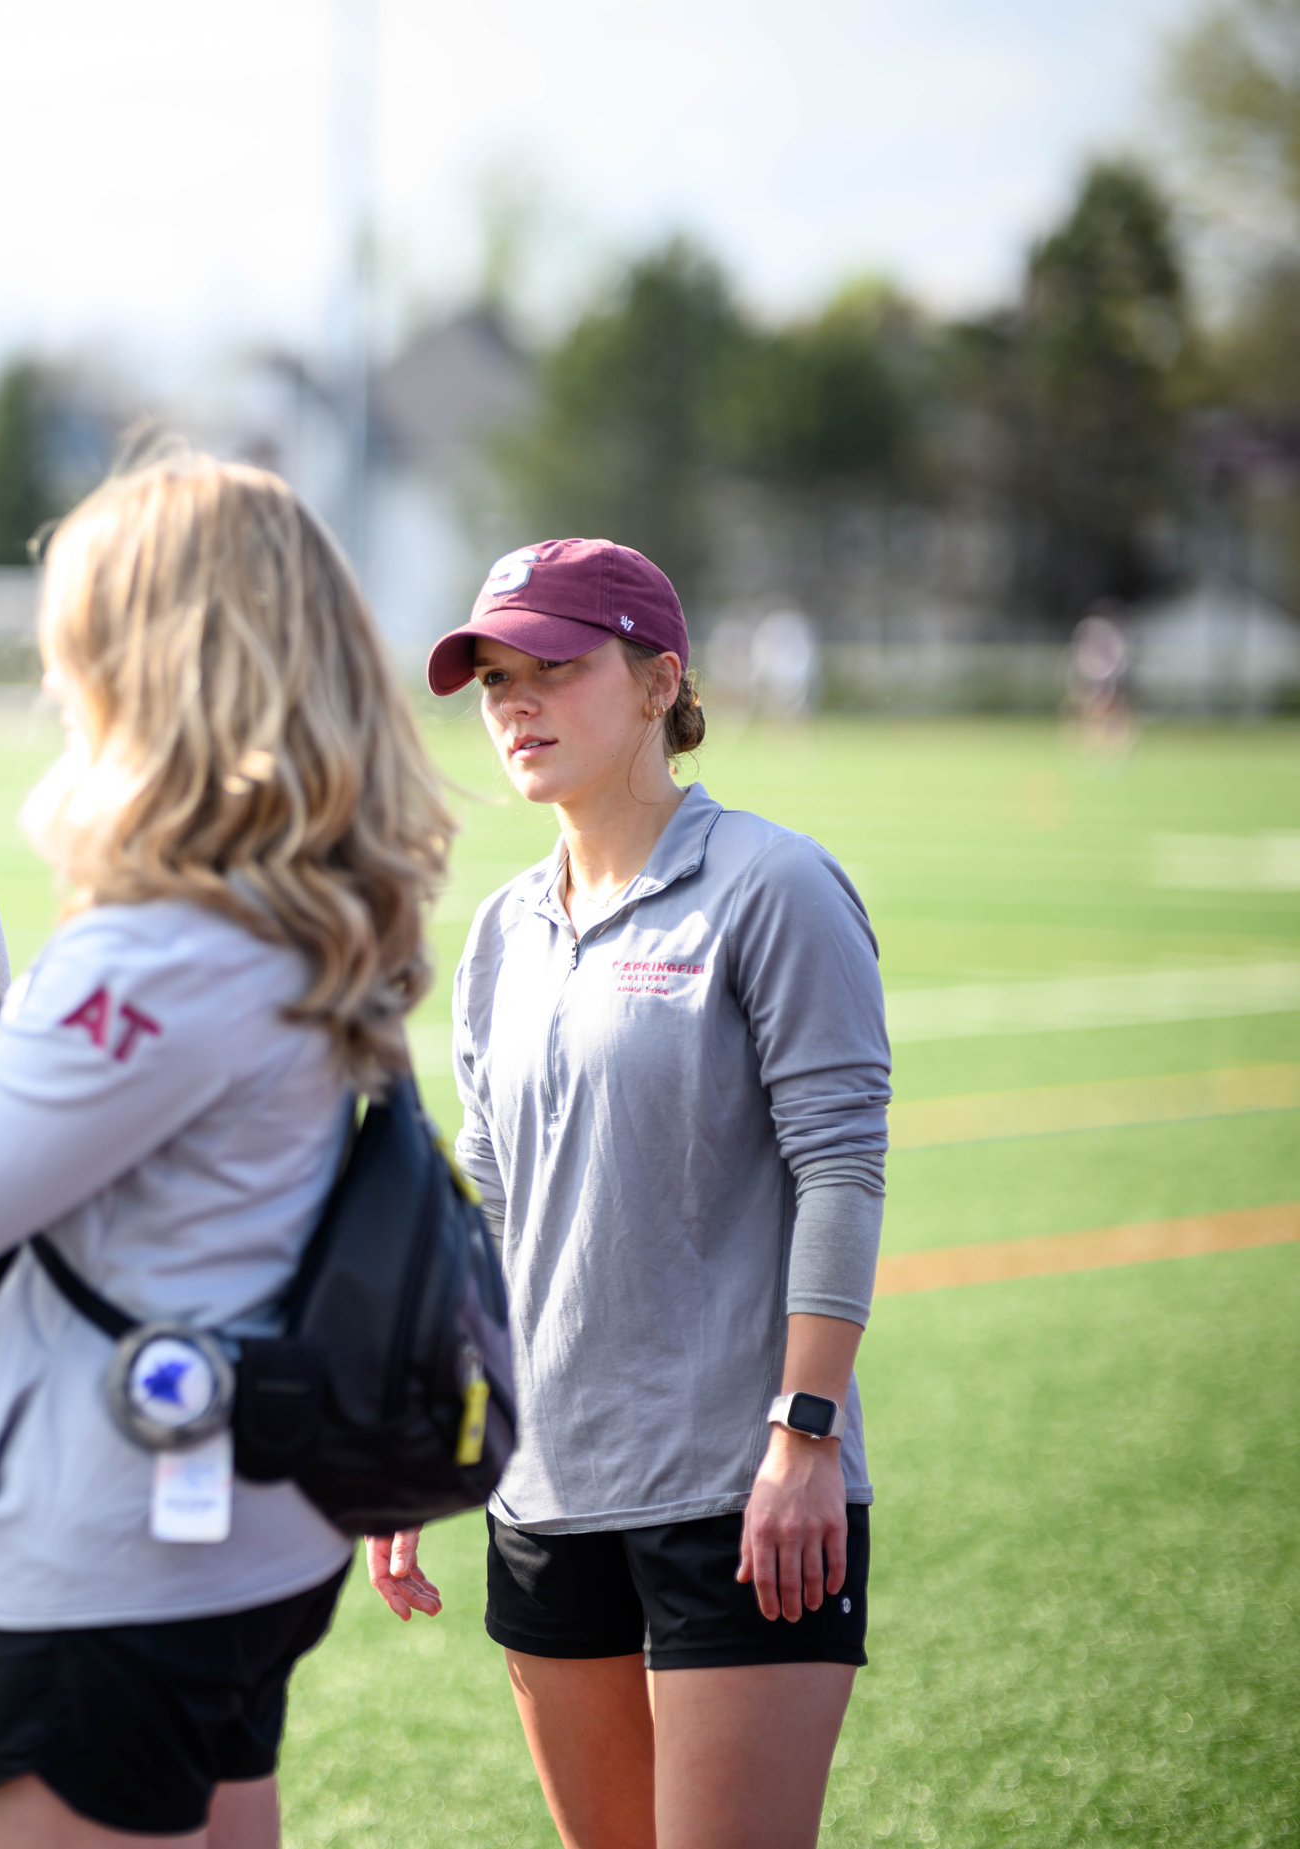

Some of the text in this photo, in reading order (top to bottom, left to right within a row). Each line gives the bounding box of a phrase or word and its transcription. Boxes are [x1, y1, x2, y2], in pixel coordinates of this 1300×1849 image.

[484, 550, 540, 597] S
[620, 974, 668, 982] COLLEGE
[623, 961, 711, 975] SPRINGFIEL
[58, 984, 163, 1064] AT
